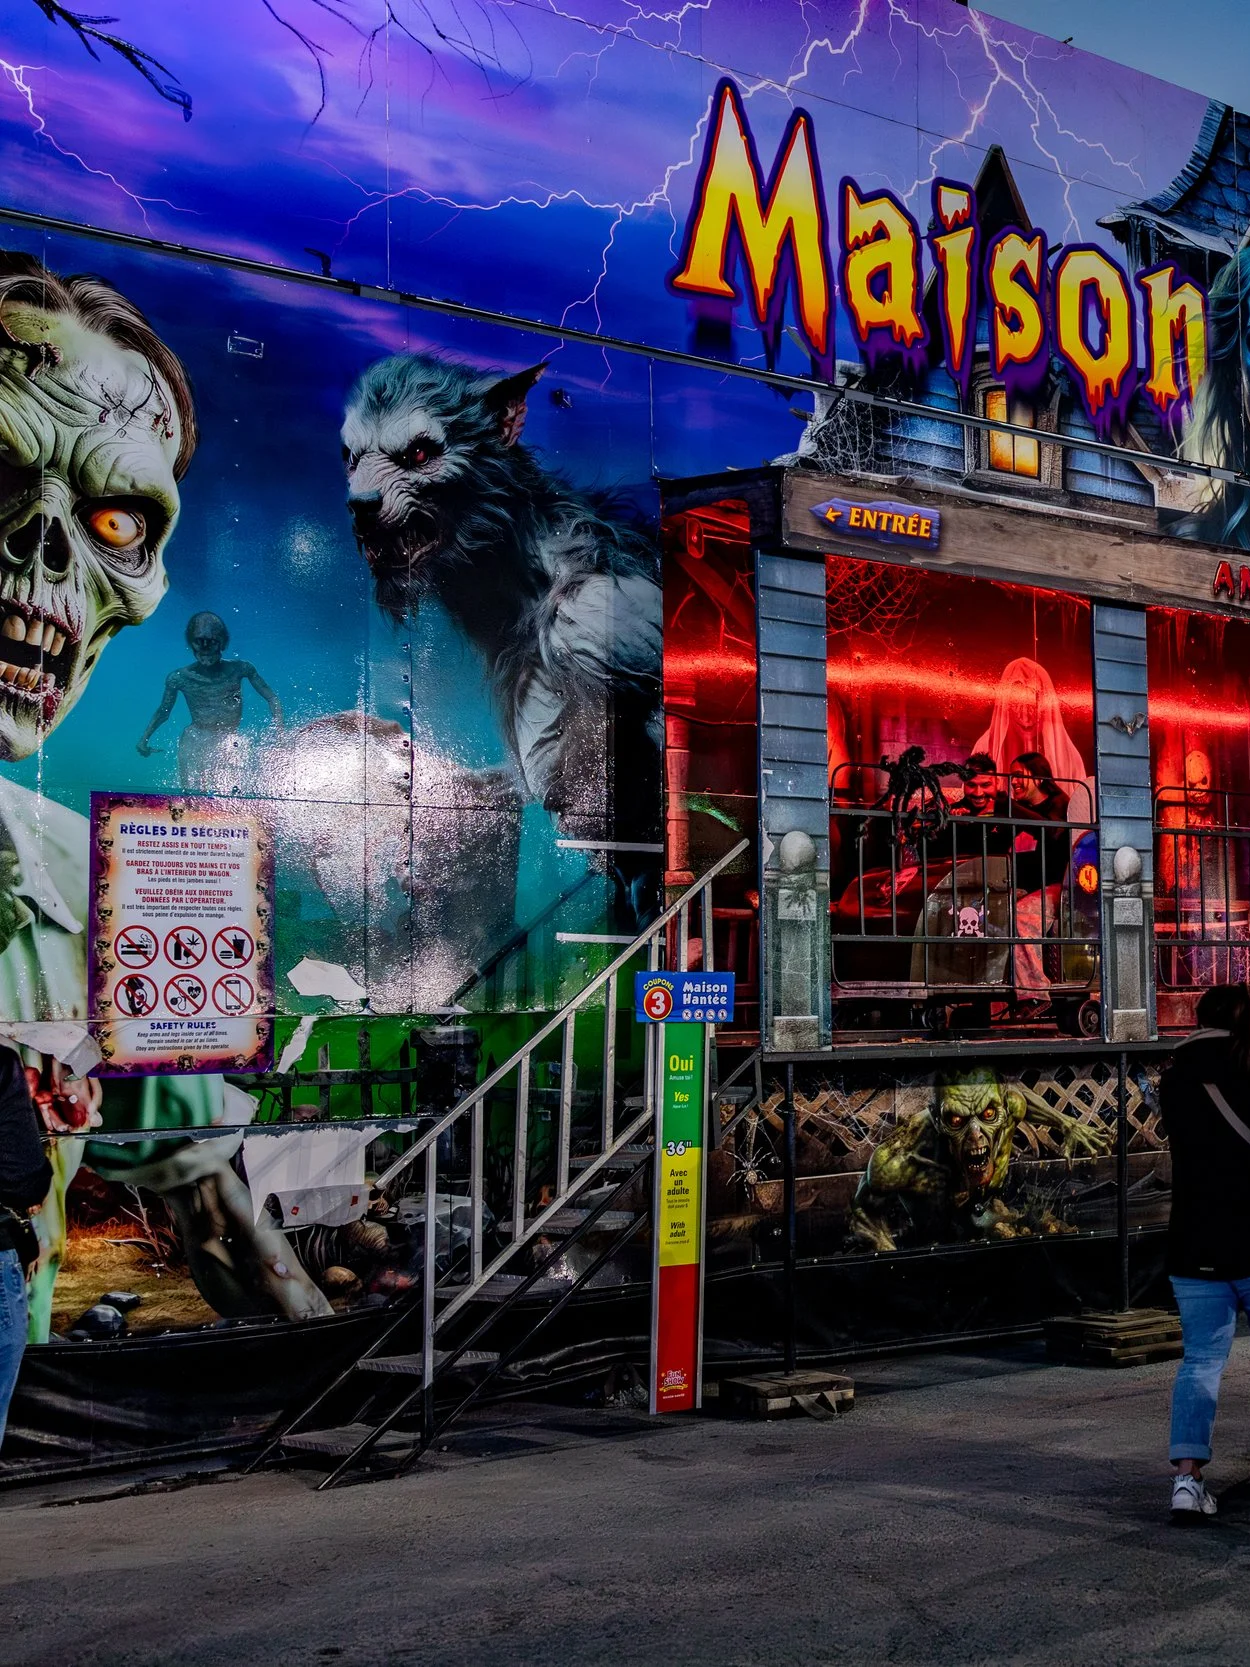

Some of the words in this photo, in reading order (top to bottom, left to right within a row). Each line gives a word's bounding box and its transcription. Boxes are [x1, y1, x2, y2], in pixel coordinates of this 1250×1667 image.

[667, 80, 1206, 415] Maison
[848, 505, 933, 540] ENTRÉE
[120, 822, 167, 836] RÈGLES
[171, 826, 187, 837] DE
[199, 889, 233, 897] DIRECTIVES
[643, 978, 675, 991] COUPONS
[682, 981, 728, 993] Maison
[651, 991, 666, 1015] 3
[682, 993, 728, 1005] Hantée
[150, 1022, 184, 1030] SAFETY
[187, 1022, 216, 1030] RULES
[669, 1054, 694, 1071] Oui
[674, 1091, 689, 1102] Yes
[670, 1169, 688, 1177] Avec
[667, 1187, 690, 1196] adulte
[670, 1221, 686, 1229] With
[669, 1230, 686, 1238] adult
